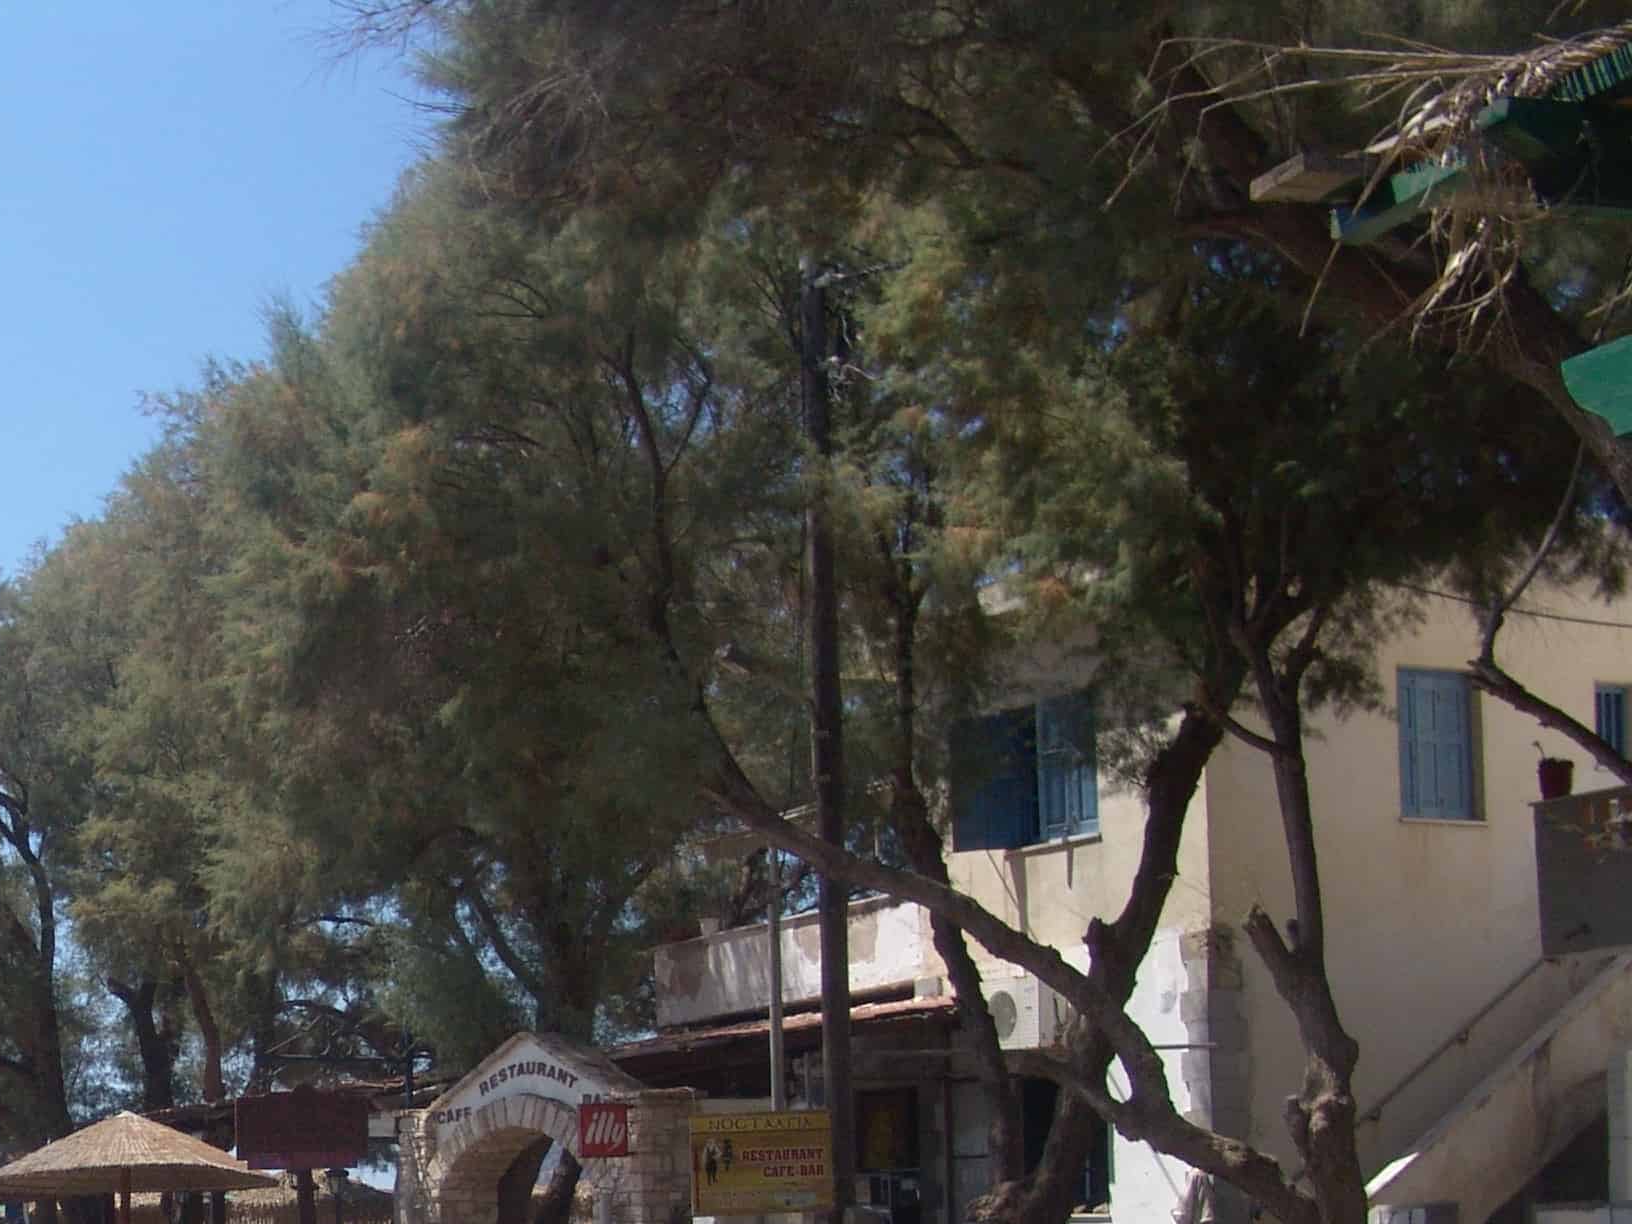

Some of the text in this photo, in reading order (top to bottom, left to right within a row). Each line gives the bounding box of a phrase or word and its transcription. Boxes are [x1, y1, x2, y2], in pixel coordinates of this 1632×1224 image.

[479, 1061, 579, 1096] RESTAURANT
[584, 1111, 626, 1151] illy
[741, 1148, 825, 1162] RESTAURANT
